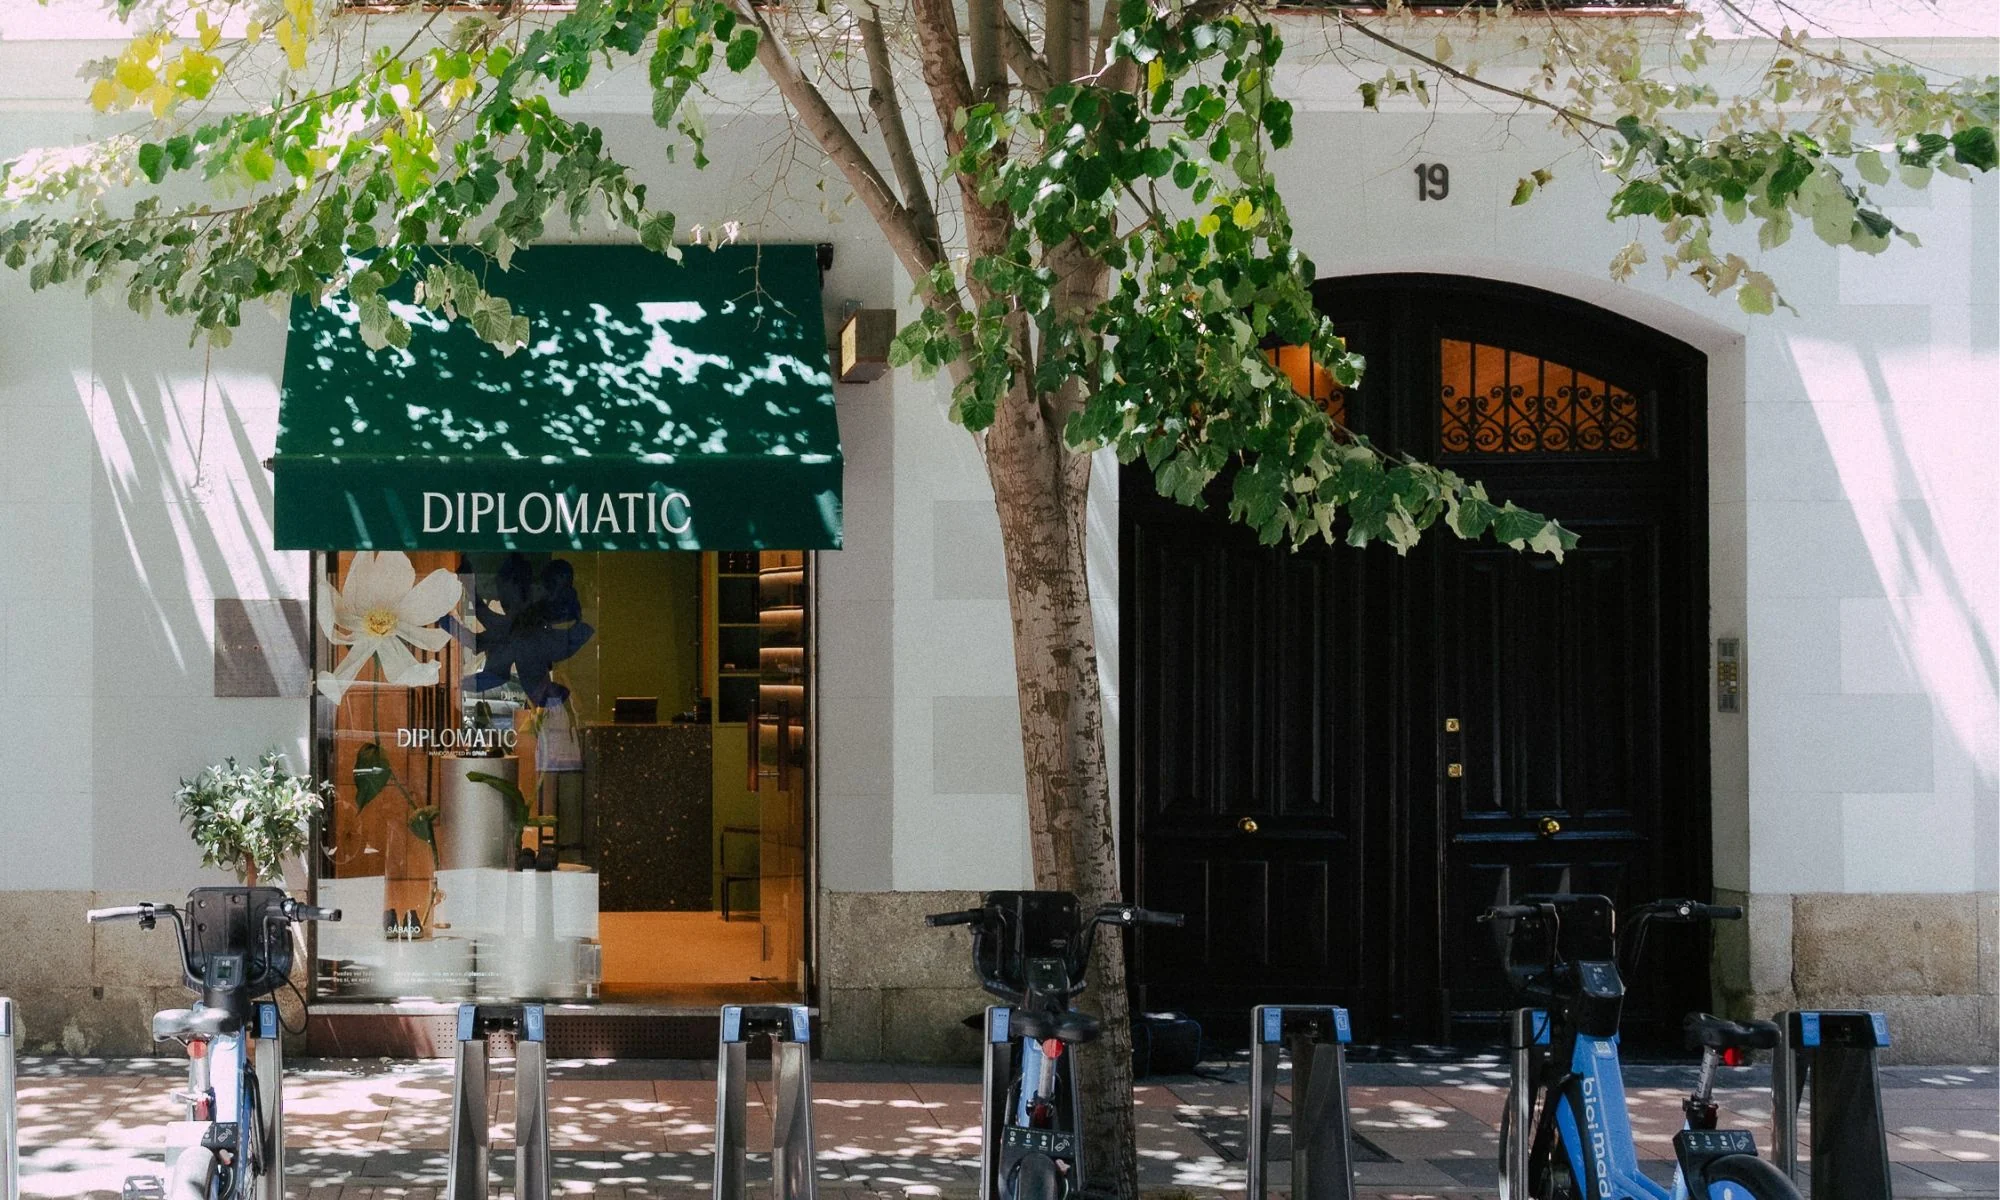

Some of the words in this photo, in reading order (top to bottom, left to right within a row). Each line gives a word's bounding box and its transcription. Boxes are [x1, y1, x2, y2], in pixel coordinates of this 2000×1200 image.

[1414, 163, 1449, 201] 19
[422, 492, 692, 534] DIPLOMATIC
[397, 728, 518, 747] DIPLOMATIC
[1582, 1077, 1612, 1198] bicimad
